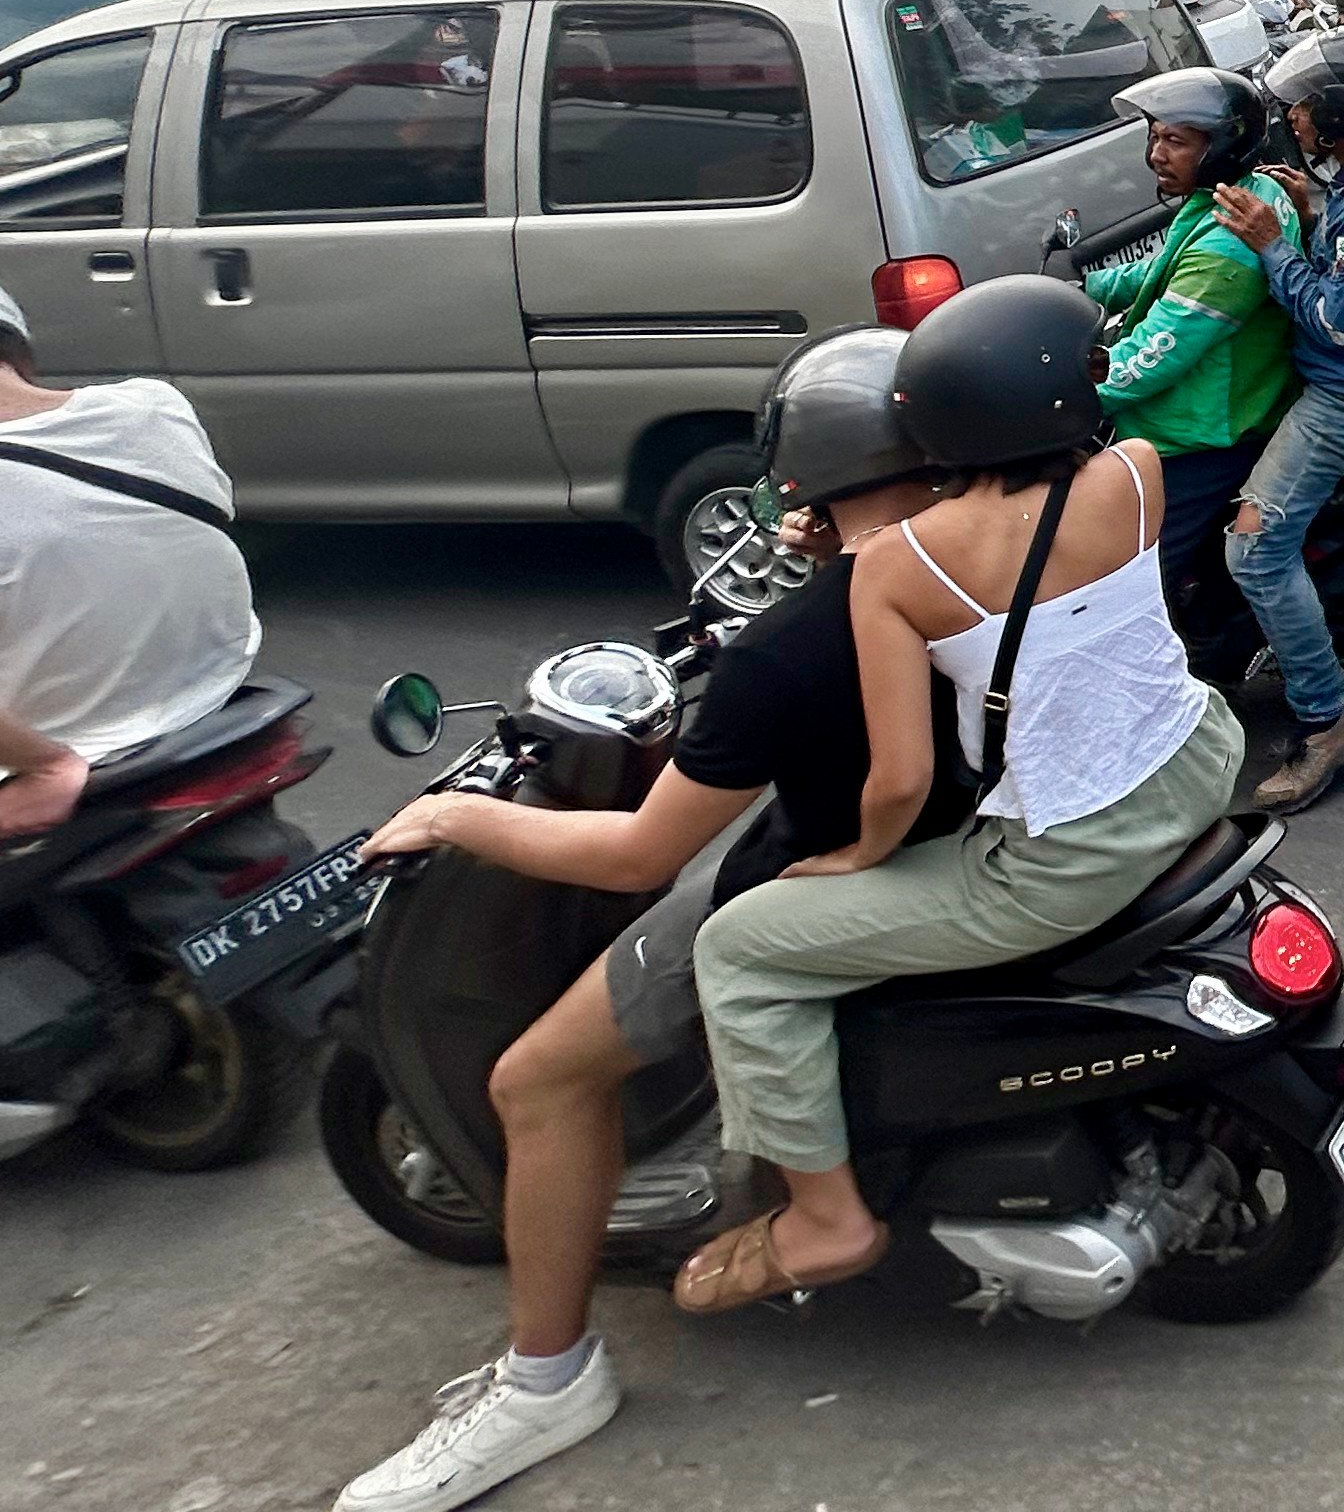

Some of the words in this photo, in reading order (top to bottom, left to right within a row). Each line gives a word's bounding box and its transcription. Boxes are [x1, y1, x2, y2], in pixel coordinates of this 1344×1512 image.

[1108, 331, 1176, 388] Grab
[190, 925, 240, 966] DK
[1000, 1044, 1177, 1092] SCOOPY
